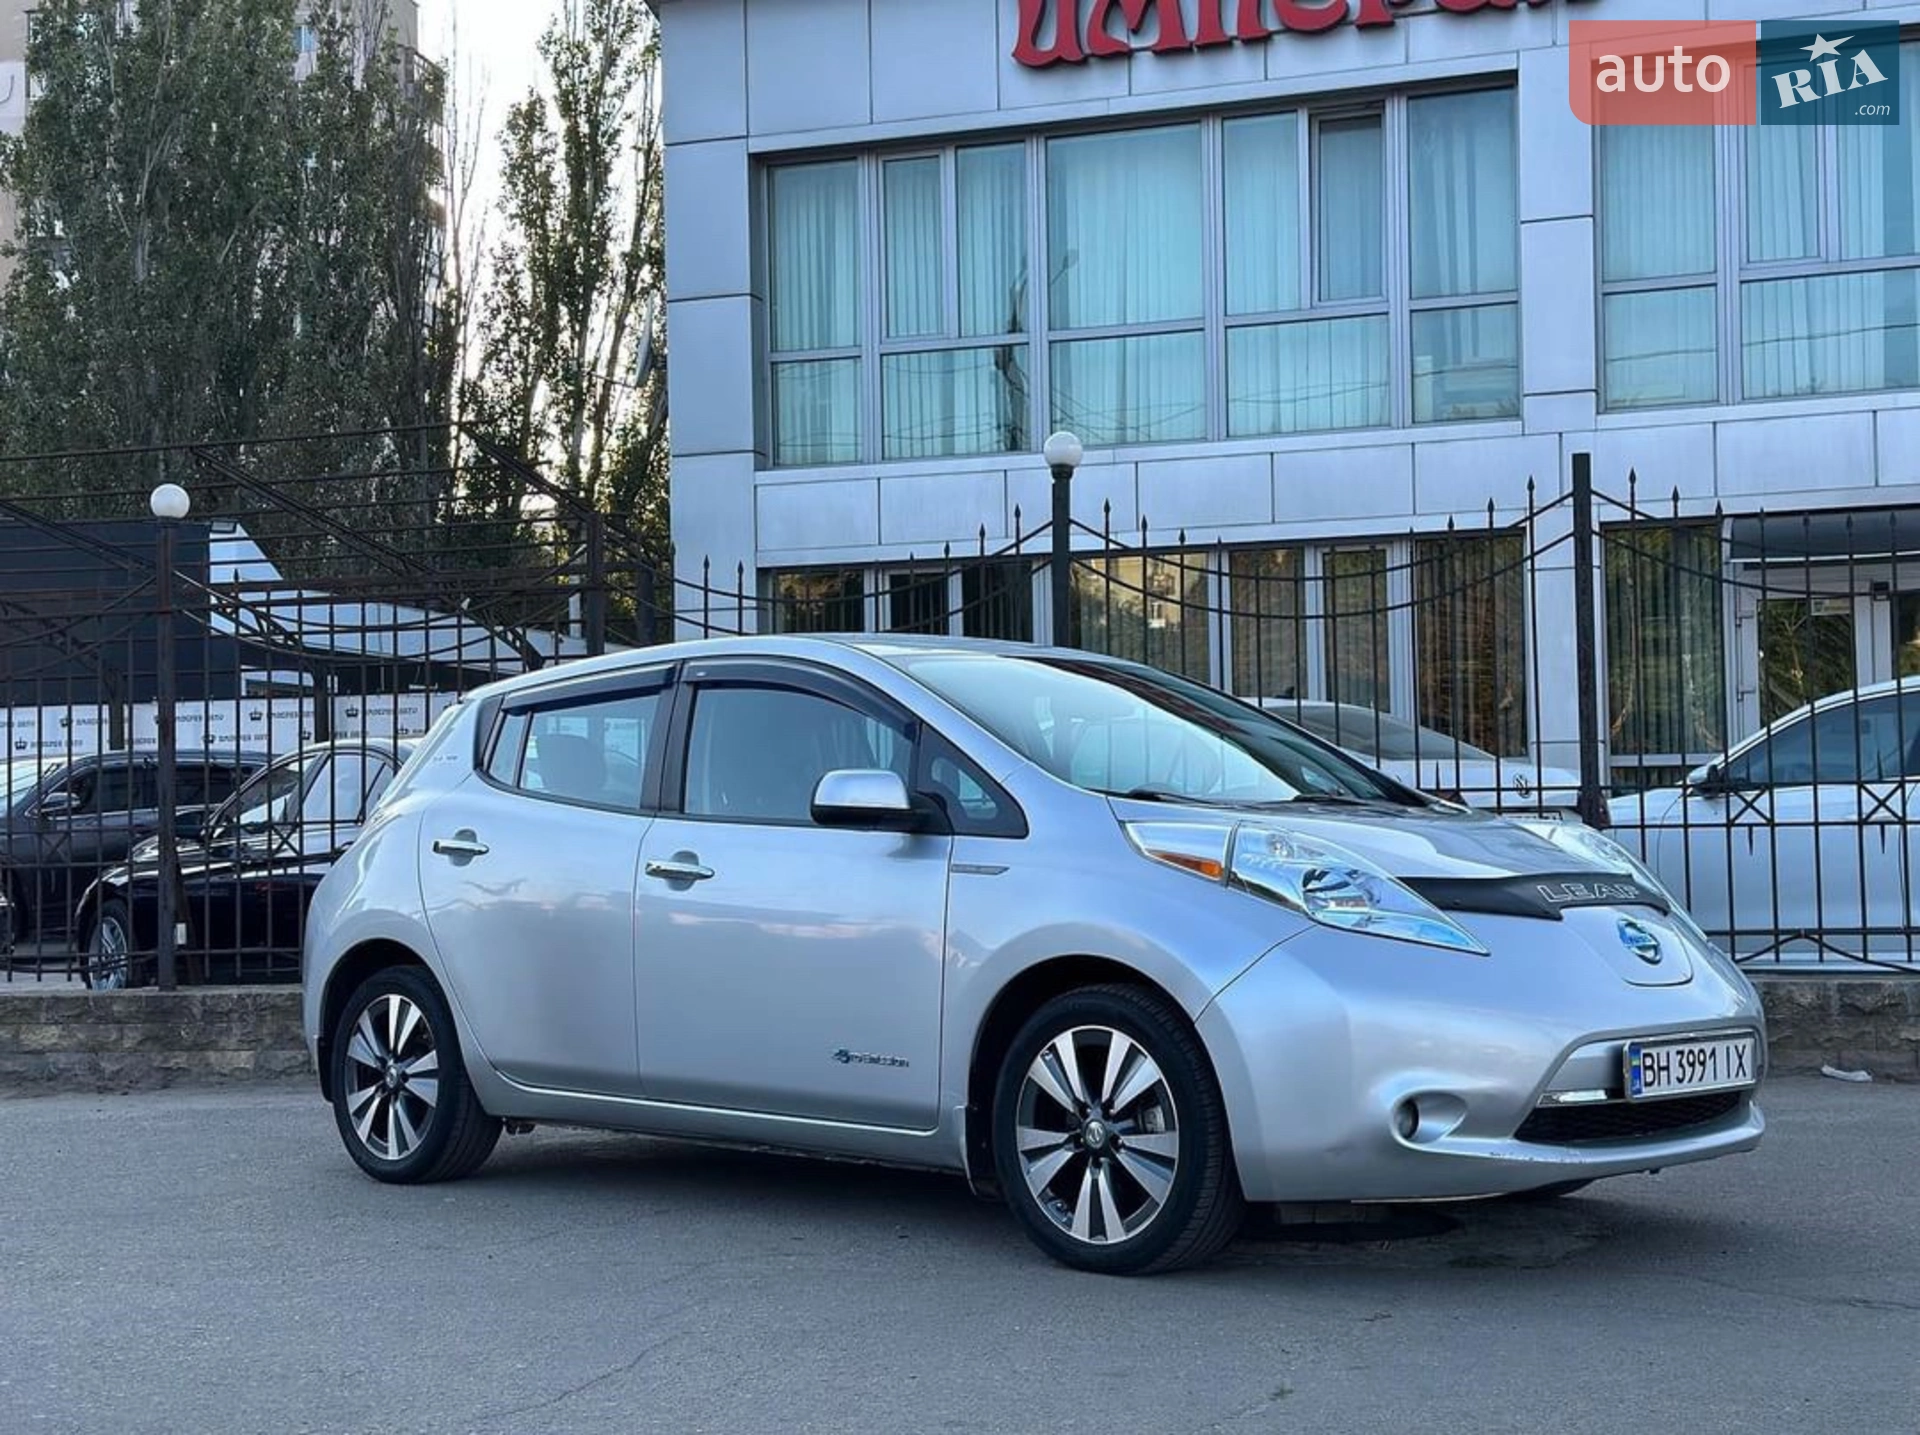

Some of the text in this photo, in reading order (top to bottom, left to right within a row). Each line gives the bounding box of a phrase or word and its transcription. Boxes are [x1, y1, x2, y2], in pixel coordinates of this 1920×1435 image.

[1641, 1044, 1747, 1088] BH 3991 IX
